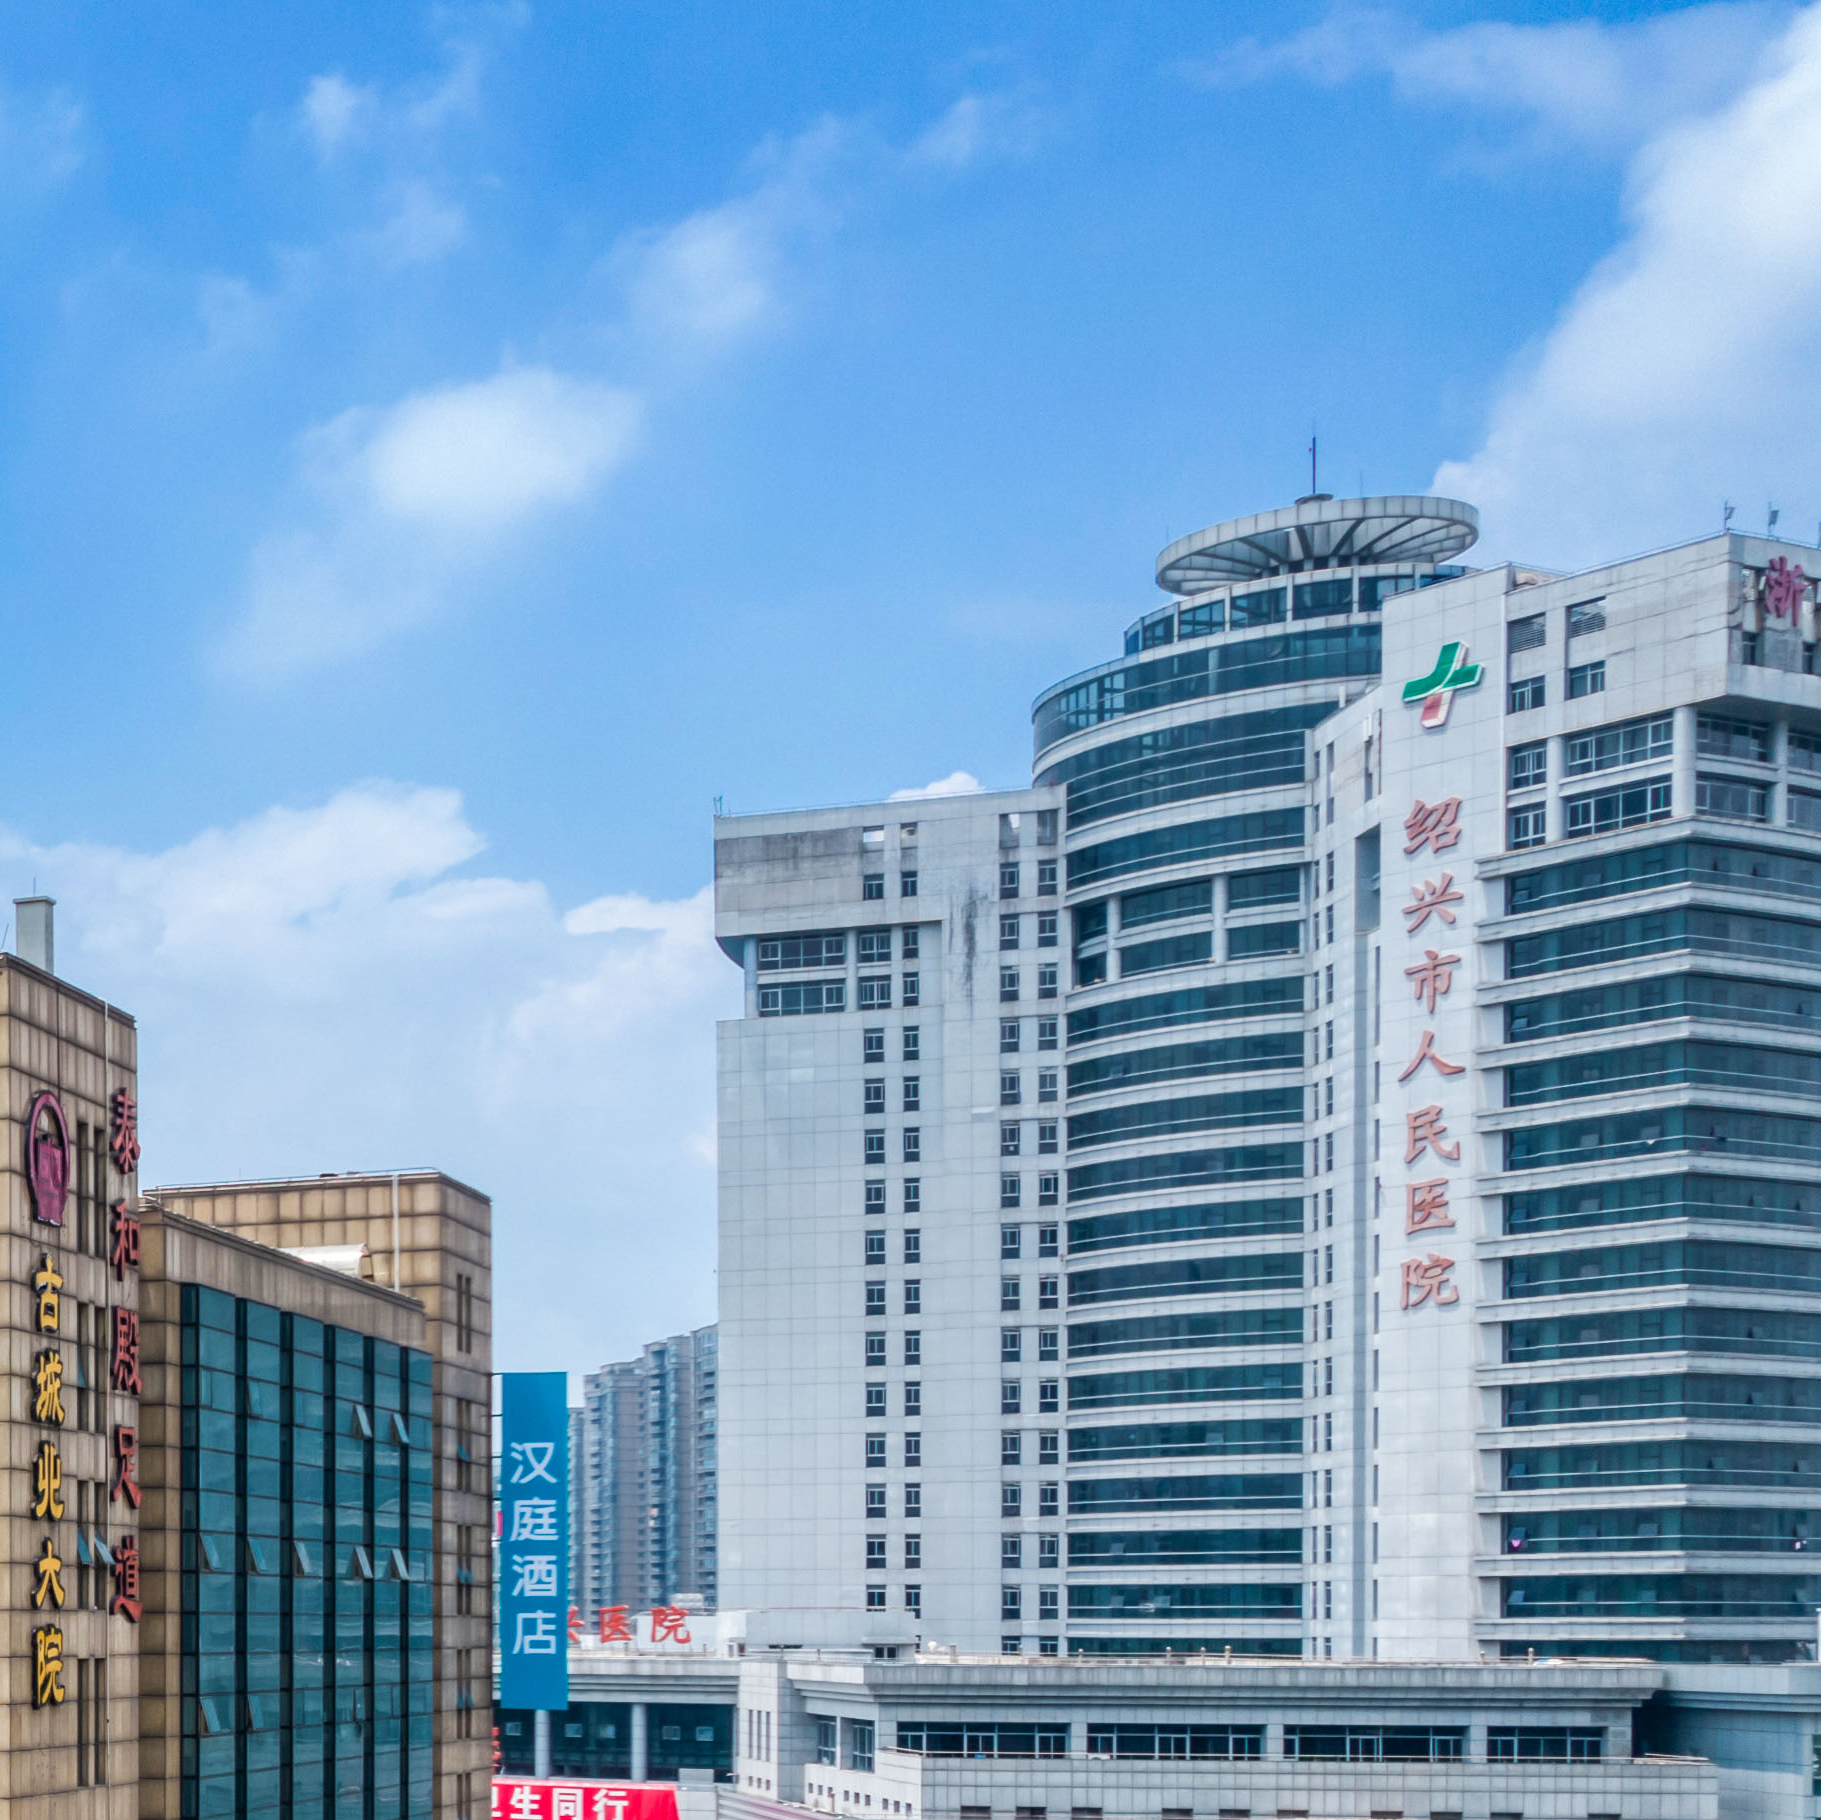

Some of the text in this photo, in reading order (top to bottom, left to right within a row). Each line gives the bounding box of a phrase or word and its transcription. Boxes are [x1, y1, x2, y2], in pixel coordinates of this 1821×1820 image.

[1764, 555, 1807, 628] 浙
[1398, 795, 1465, 1310] 绍兴市人民医院
[31, 1252, 65, 1709] 古城北大院
[110, 1087, 142, 1623] 泰和殿足道
[510, 1441, 558, 1655] 汉庭酒店
